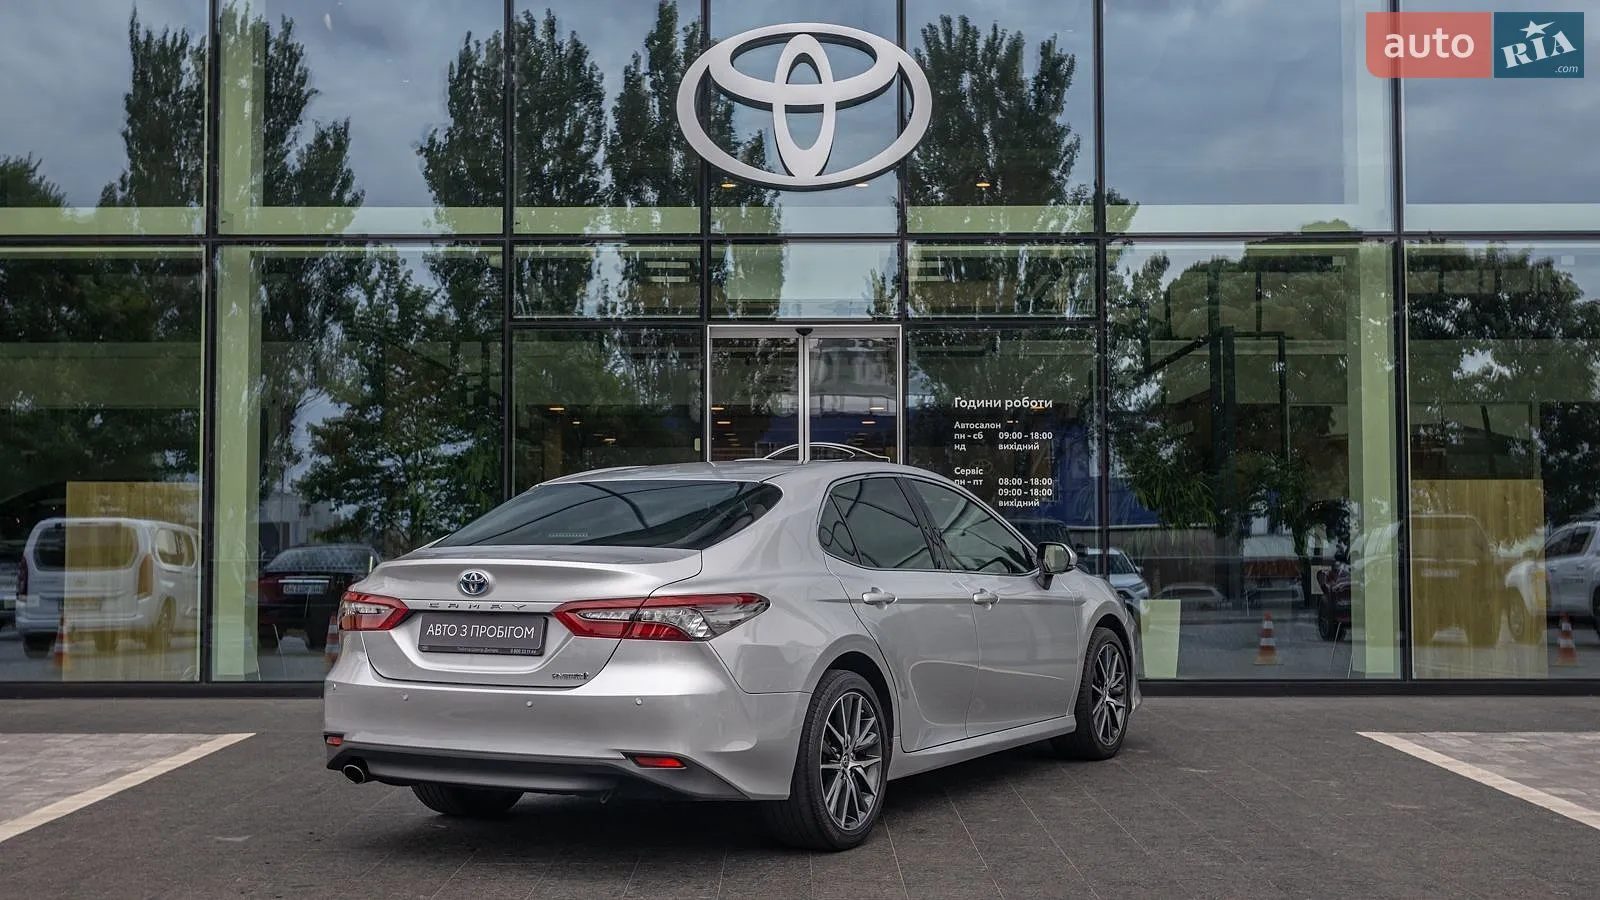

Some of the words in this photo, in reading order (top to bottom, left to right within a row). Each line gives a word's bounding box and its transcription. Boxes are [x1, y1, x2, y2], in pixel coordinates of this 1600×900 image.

[954, 397, 1001, 410] Години
[1005, 397, 1052, 410] роботи
[999, 443, 1039, 451] вихідний
[954, 468, 984, 476] Сервіс
[999, 499, 1039, 507] вихідний
[426, 624, 458, 637] АВТО
[470, 625, 535, 639] ПРОБІГОМ
